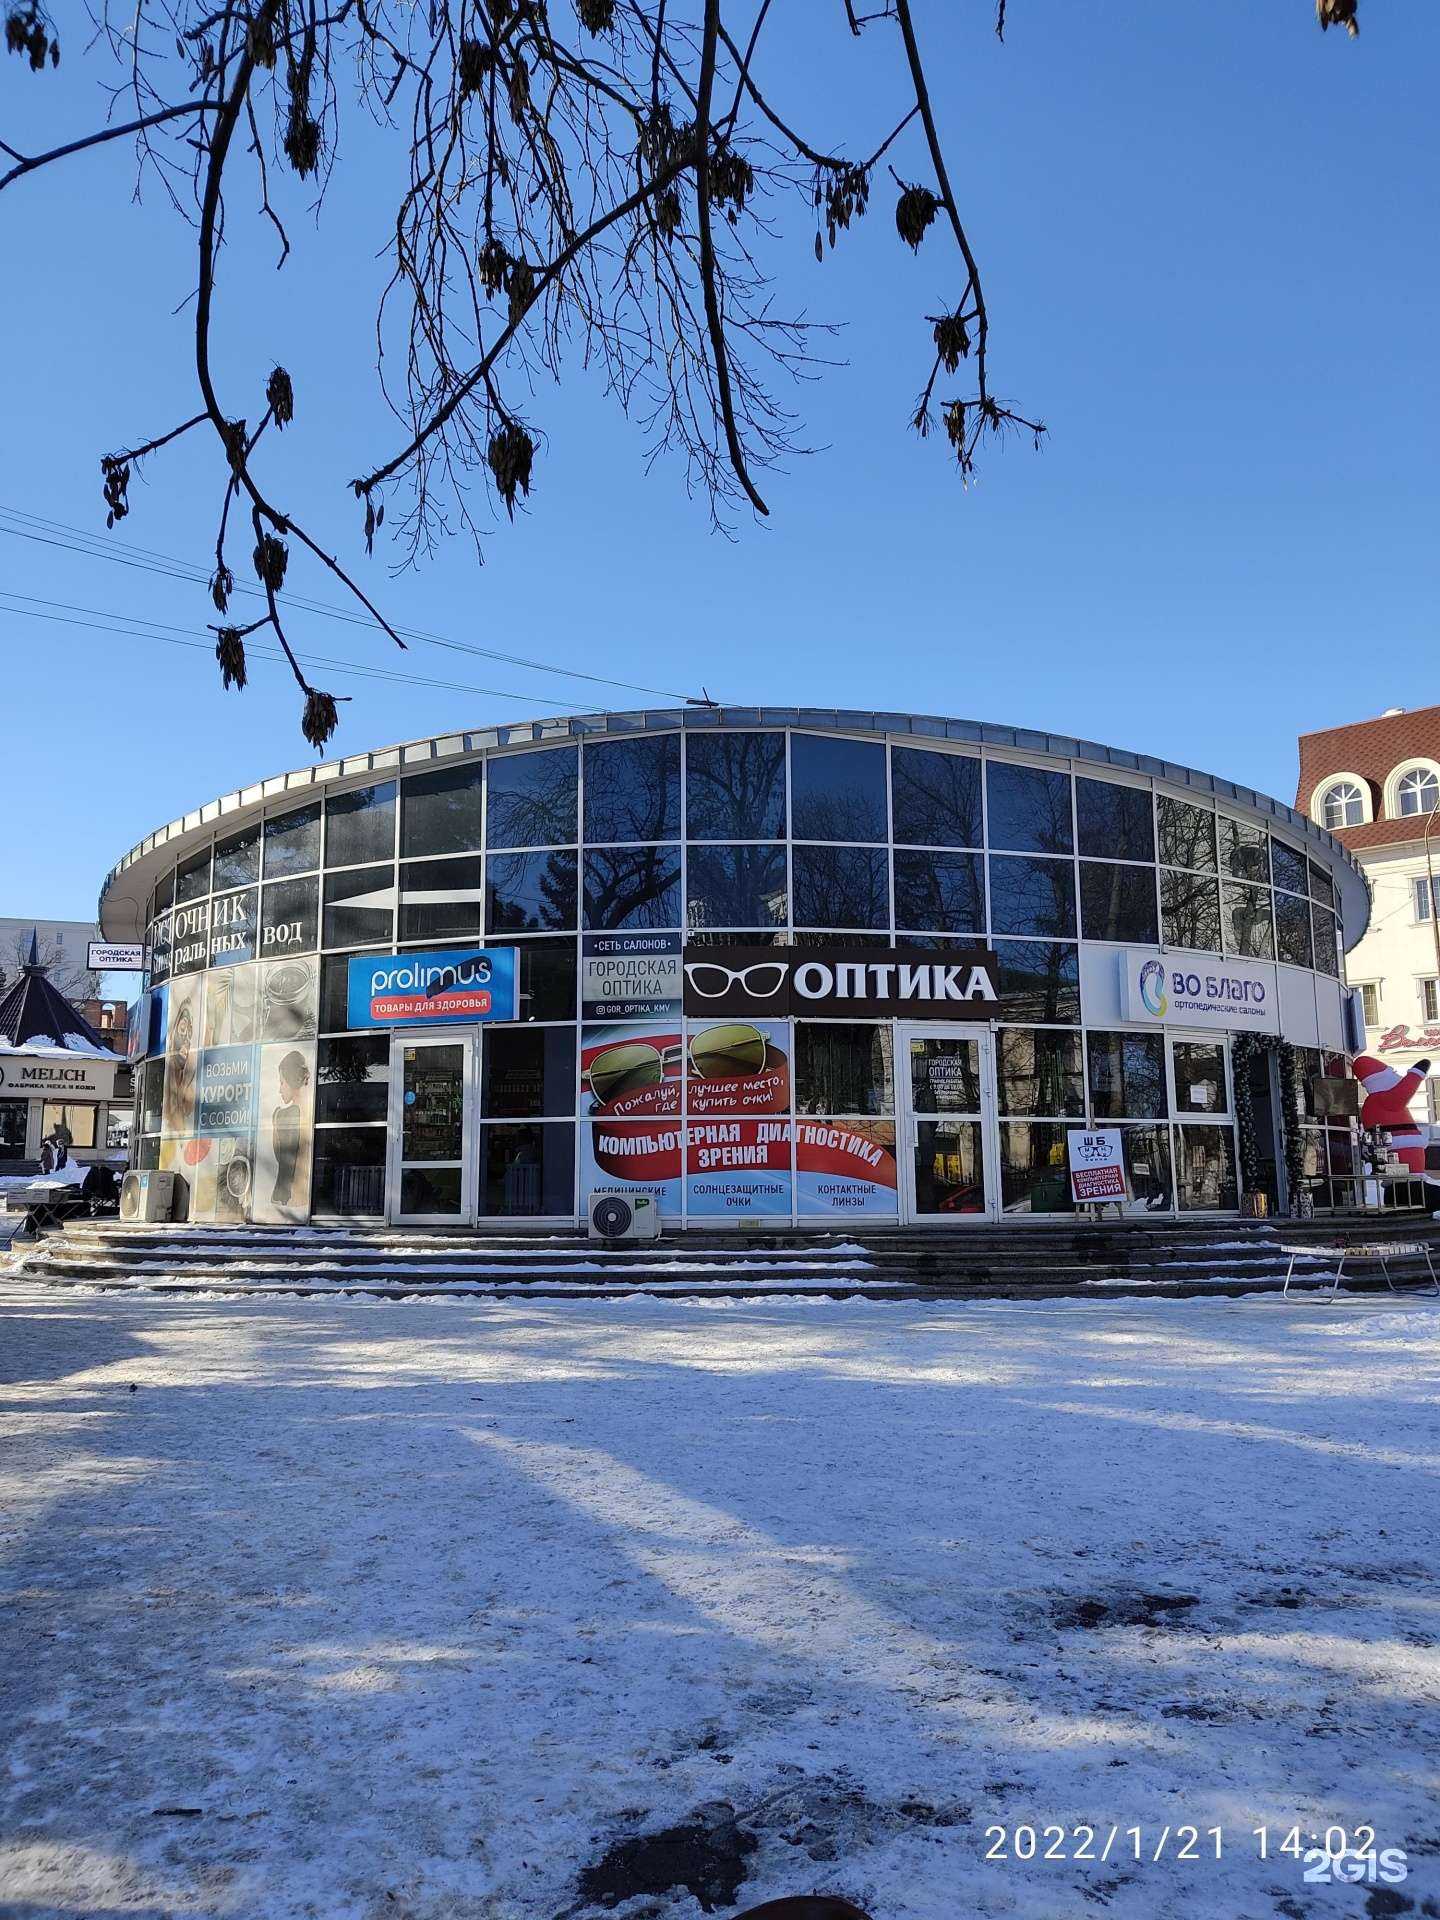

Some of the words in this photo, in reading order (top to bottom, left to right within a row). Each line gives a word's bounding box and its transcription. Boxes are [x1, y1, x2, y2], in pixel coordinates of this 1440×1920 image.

[263, 922, 304, 945] вод
[91, 949, 141, 957] ГОРОДСКАЯ
[598, 940, 621, 951] СЕТЬ
[623, 939, 667, 950] САЛОНОВ
[589, 959, 676, 979] ГОРОДСКАЯ
[371, 962, 492, 997] prolimus
[602, 979, 663, 996] ОПТИКА
[793, 962, 999, 1001] ОПТИКА
[1172, 972, 1201, 997] ВО
[374, 1003, 413, 1013] ТОВАРЫ
[414, 1001, 435, 1013] ДЛЯ
[437, 998, 487, 1011] ЗДОРОВЬЯ
[1175, 1000, 1238, 1013] ортопедические
[1239, 1005, 1266, 1016] салоны
[22, 1067, 86, 1081] MELICH
[206, 1060, 248, 1078] ВОЗЬМИ
[928, 1066, 963, 1077] ОПТИКА
[199, 1082, 253, 1104] КУРОРТ
[613, 1085, 680, 1116] Пожалуй,
[689, 1079, 737, 1097] лучшее
[743, 1074, 784, 1091] место,
[655, 1100, 678, 1113] где
[692, 1097, 737, 1111] купить
[743, 1091, 774, 1106] очки!
[200, 1112, 208, 1127] С
[209, 1106, 250, 1126] СОБОЙ!
[599, 1123, 741, 1156] КОМПЬЮТЕРНАЯ
[756, 1123, 883, 1167] ДИАГНОСТИКА
[698, 1144, 768, 1168] ЗРЕНИЯ
[1075, 1167, 1118, 1179] БЕСПЛАТНАЯ
[693, 1184, 784, 1196] СОЛНЦЕЗАЩИТНЫЕ
[818, 1184, 876, 1194] КОНТАКТНЫЕ
[1080, 1183, 1122, 1197] ЗРЕНИЯ
[726, 1197, 752, 1207] ОЧКИ
[831, 1197, 865, 1207] ЛИНЗЫ
